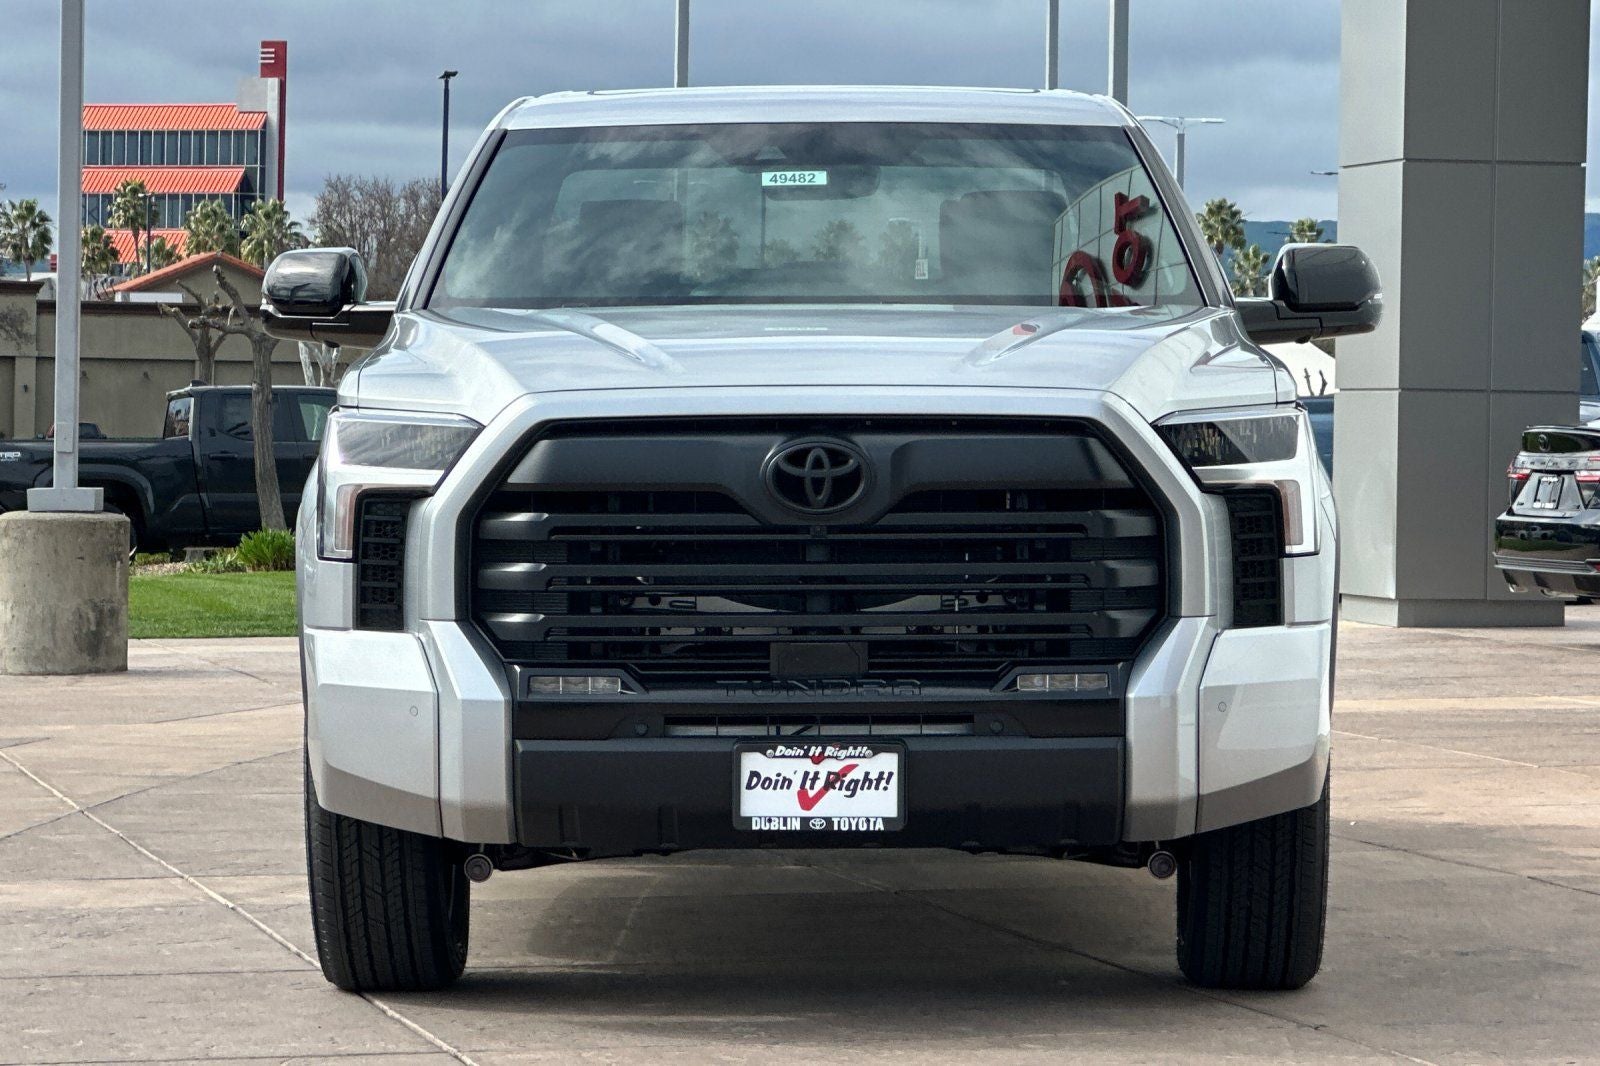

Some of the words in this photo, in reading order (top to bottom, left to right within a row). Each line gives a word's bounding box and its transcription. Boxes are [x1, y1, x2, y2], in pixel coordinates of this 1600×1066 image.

[769, 172, 816, 184] 49482
[716, 679, 921, 697] TUNDRA
[774, 745, 807, 757] Doin'
[808, 745, 823, 757] It
[824, 745, 867, 760] Right!
[745, 770, 797, 791] Doin'
[799, 770, 820, 791] It
[822, 770, 894, 798] Right!
[752, 817, 801, 831] DUBLIN
[832, 817, 884, 831] TOYOTA
